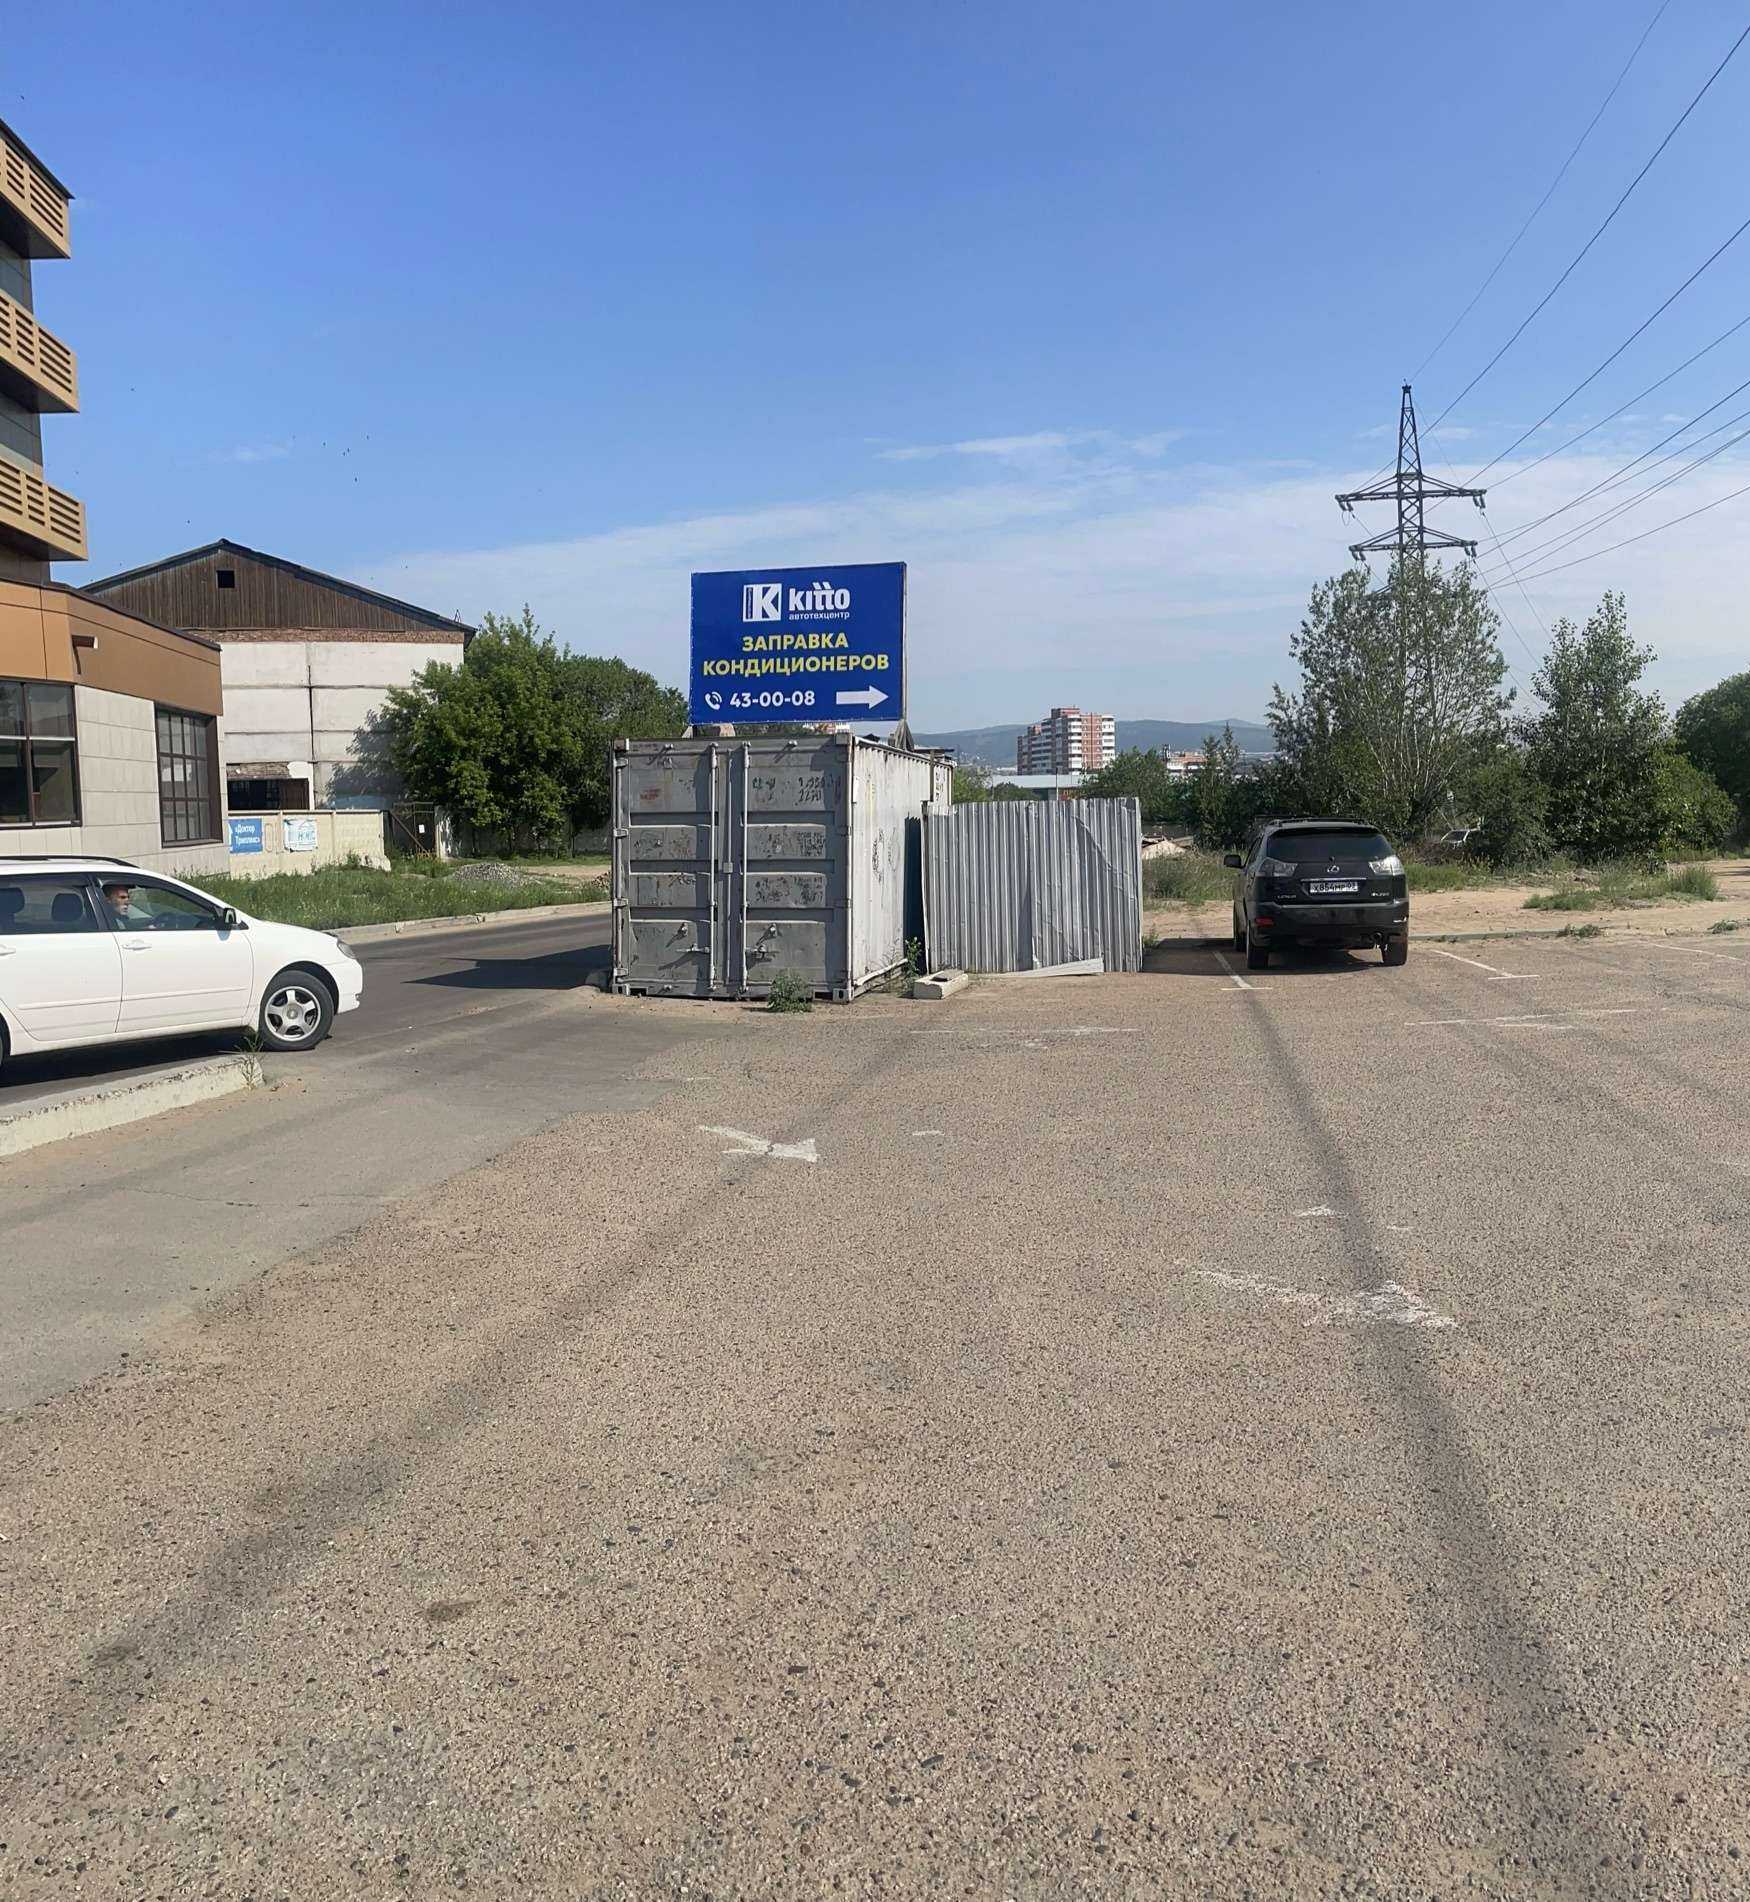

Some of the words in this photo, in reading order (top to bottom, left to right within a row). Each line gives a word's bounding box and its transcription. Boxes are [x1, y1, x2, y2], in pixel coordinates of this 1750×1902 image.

[789, 611, 850, 620] автотехцентр
[742, 632, 849, 652] ЗАПРАВКА
[703, 654, 889, 677] КОНДИЦИОНЕРОВ
[729, 690, 816, 708] 43-00-08
